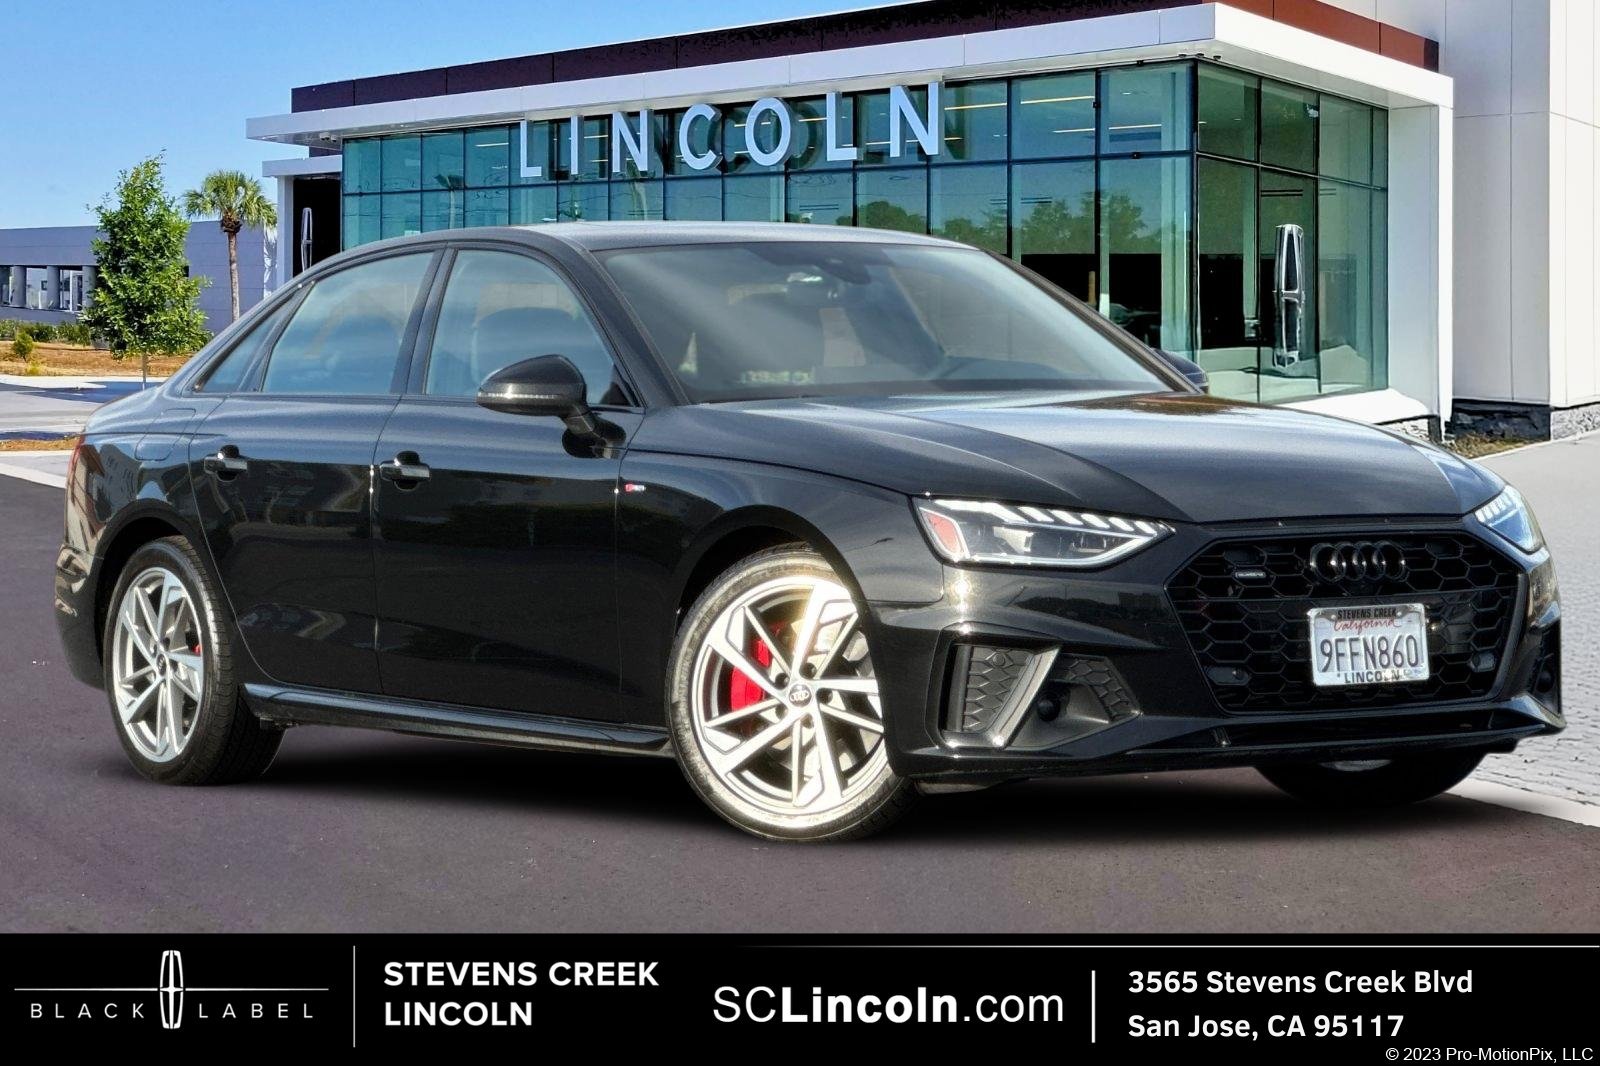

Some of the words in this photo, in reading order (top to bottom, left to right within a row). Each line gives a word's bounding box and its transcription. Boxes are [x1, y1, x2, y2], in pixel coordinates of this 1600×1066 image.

[520, 81, 942, 178] LINCOLN
[1333, 618, 1402, 634] California
[1337, 608, 1371, 619] STEVENS
[1373, 608, 1398, 618] CREEK
[1320, 634, 1419, 673] 9FFN860
